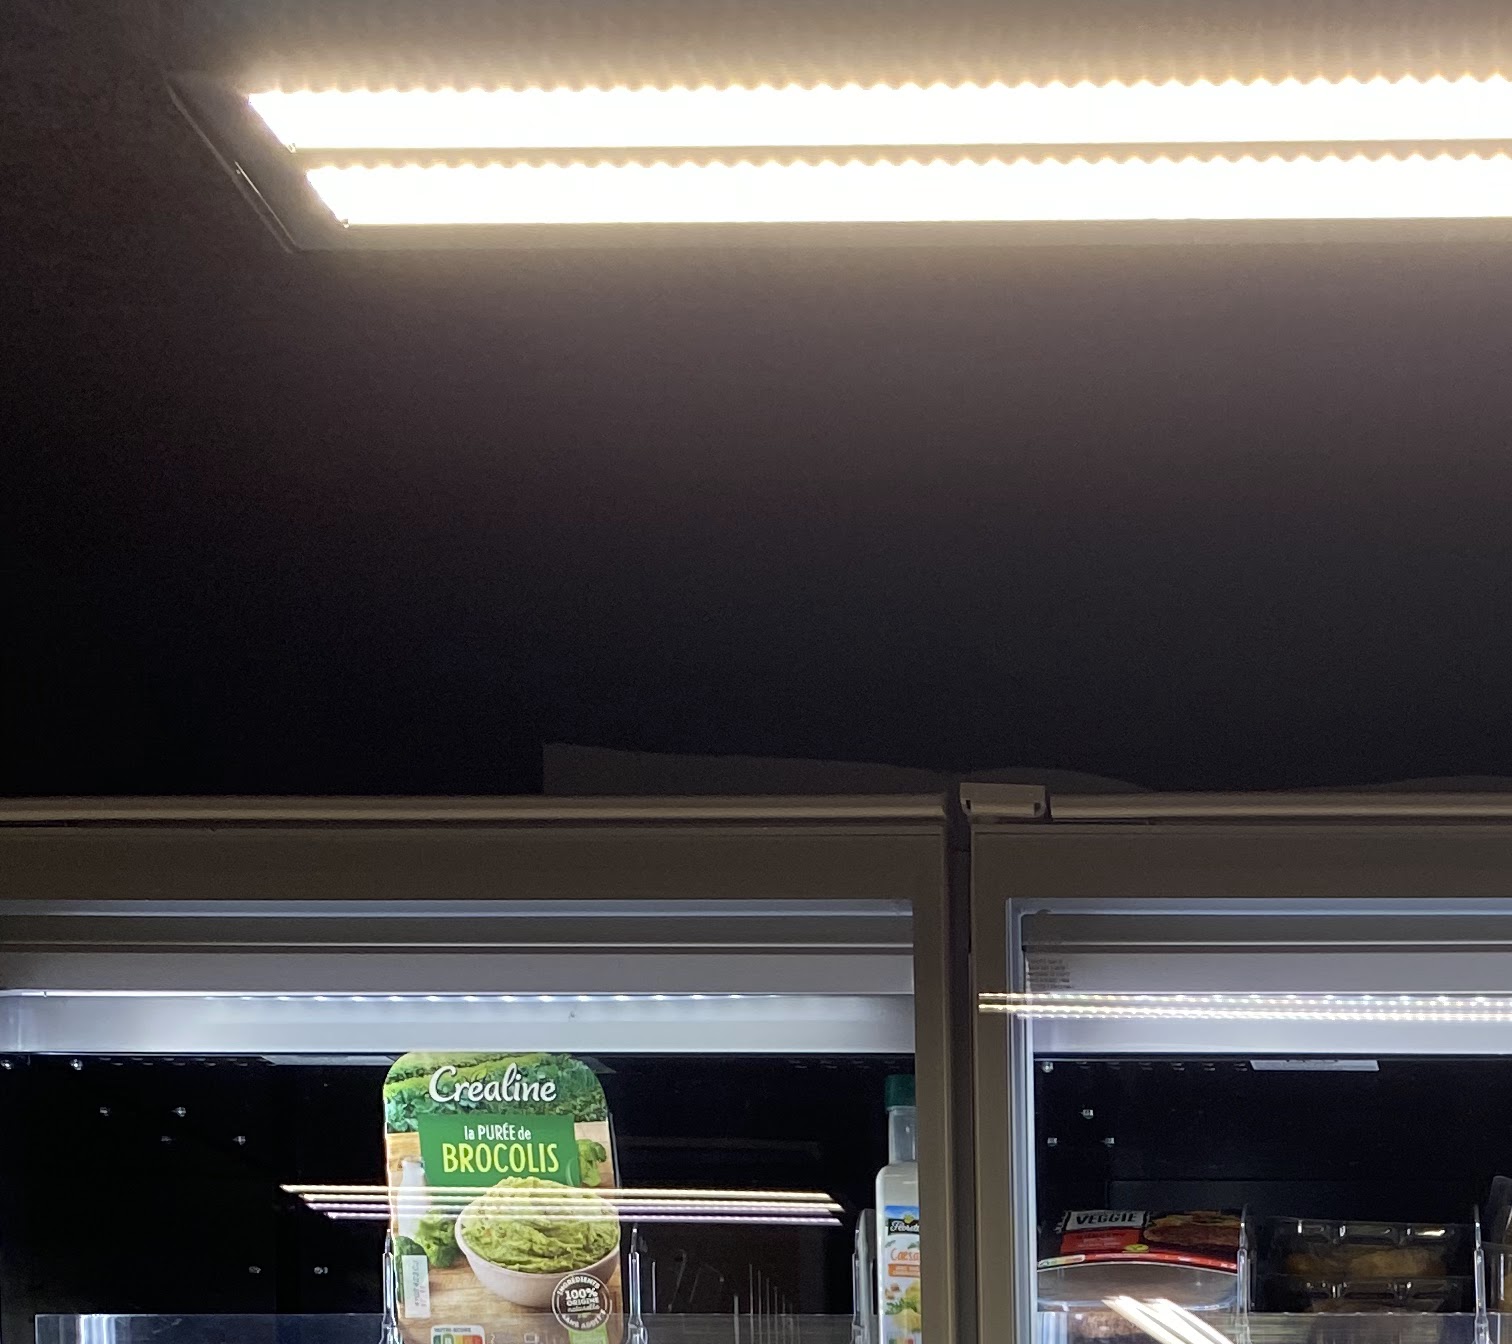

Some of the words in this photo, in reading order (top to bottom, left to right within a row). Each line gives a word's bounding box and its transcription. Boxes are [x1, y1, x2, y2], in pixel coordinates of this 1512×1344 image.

[464, 1126, 475, 1140] la
[478, 1123, 516, 1140] PURÉE
[517, 1127, 531, 1140] de
[442, 1143, 560, 1173] BROCOLIS
[1076, 1212, 1137, 1226] VEGGIE
[565, 1288, 598, 1299] 100%
